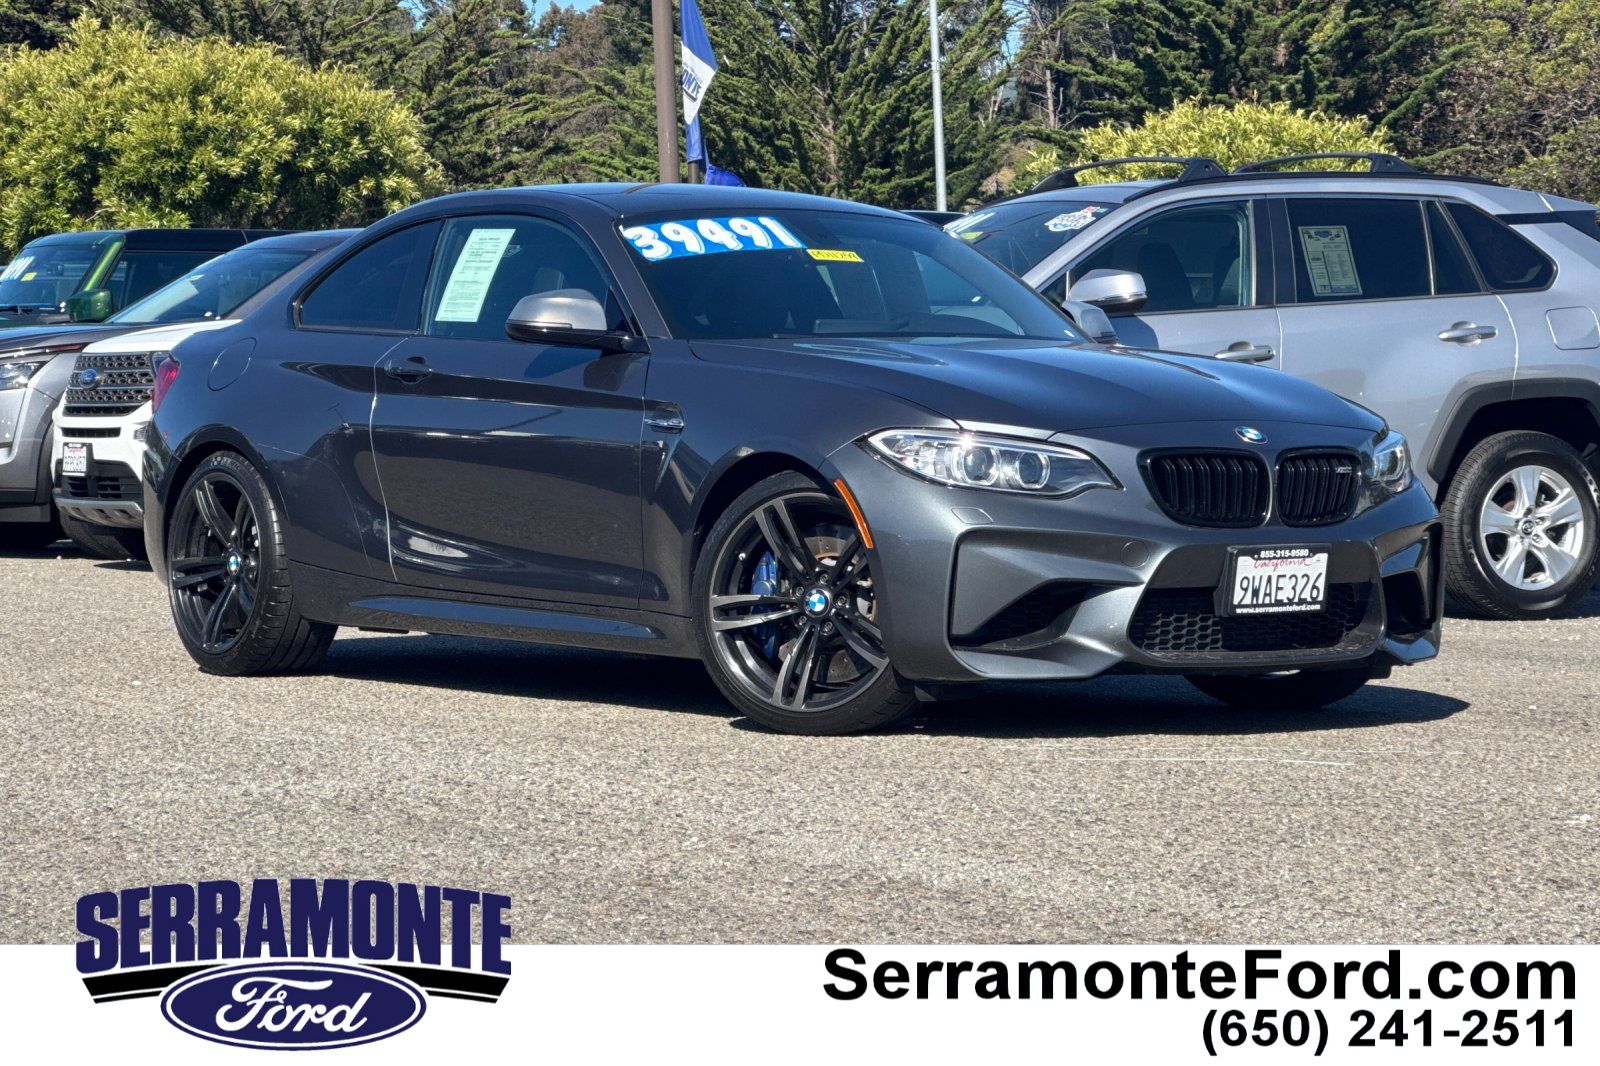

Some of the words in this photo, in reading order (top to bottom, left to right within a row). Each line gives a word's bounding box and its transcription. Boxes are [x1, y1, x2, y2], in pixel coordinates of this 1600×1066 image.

[620, 216, 803, 260] 39491
[1260, 549, 1309, 558] 855-315-9580
[1238, 572, 1323, 605] 9WAE326
[1235, 604, 1321, 613] www.serramonteford.com
